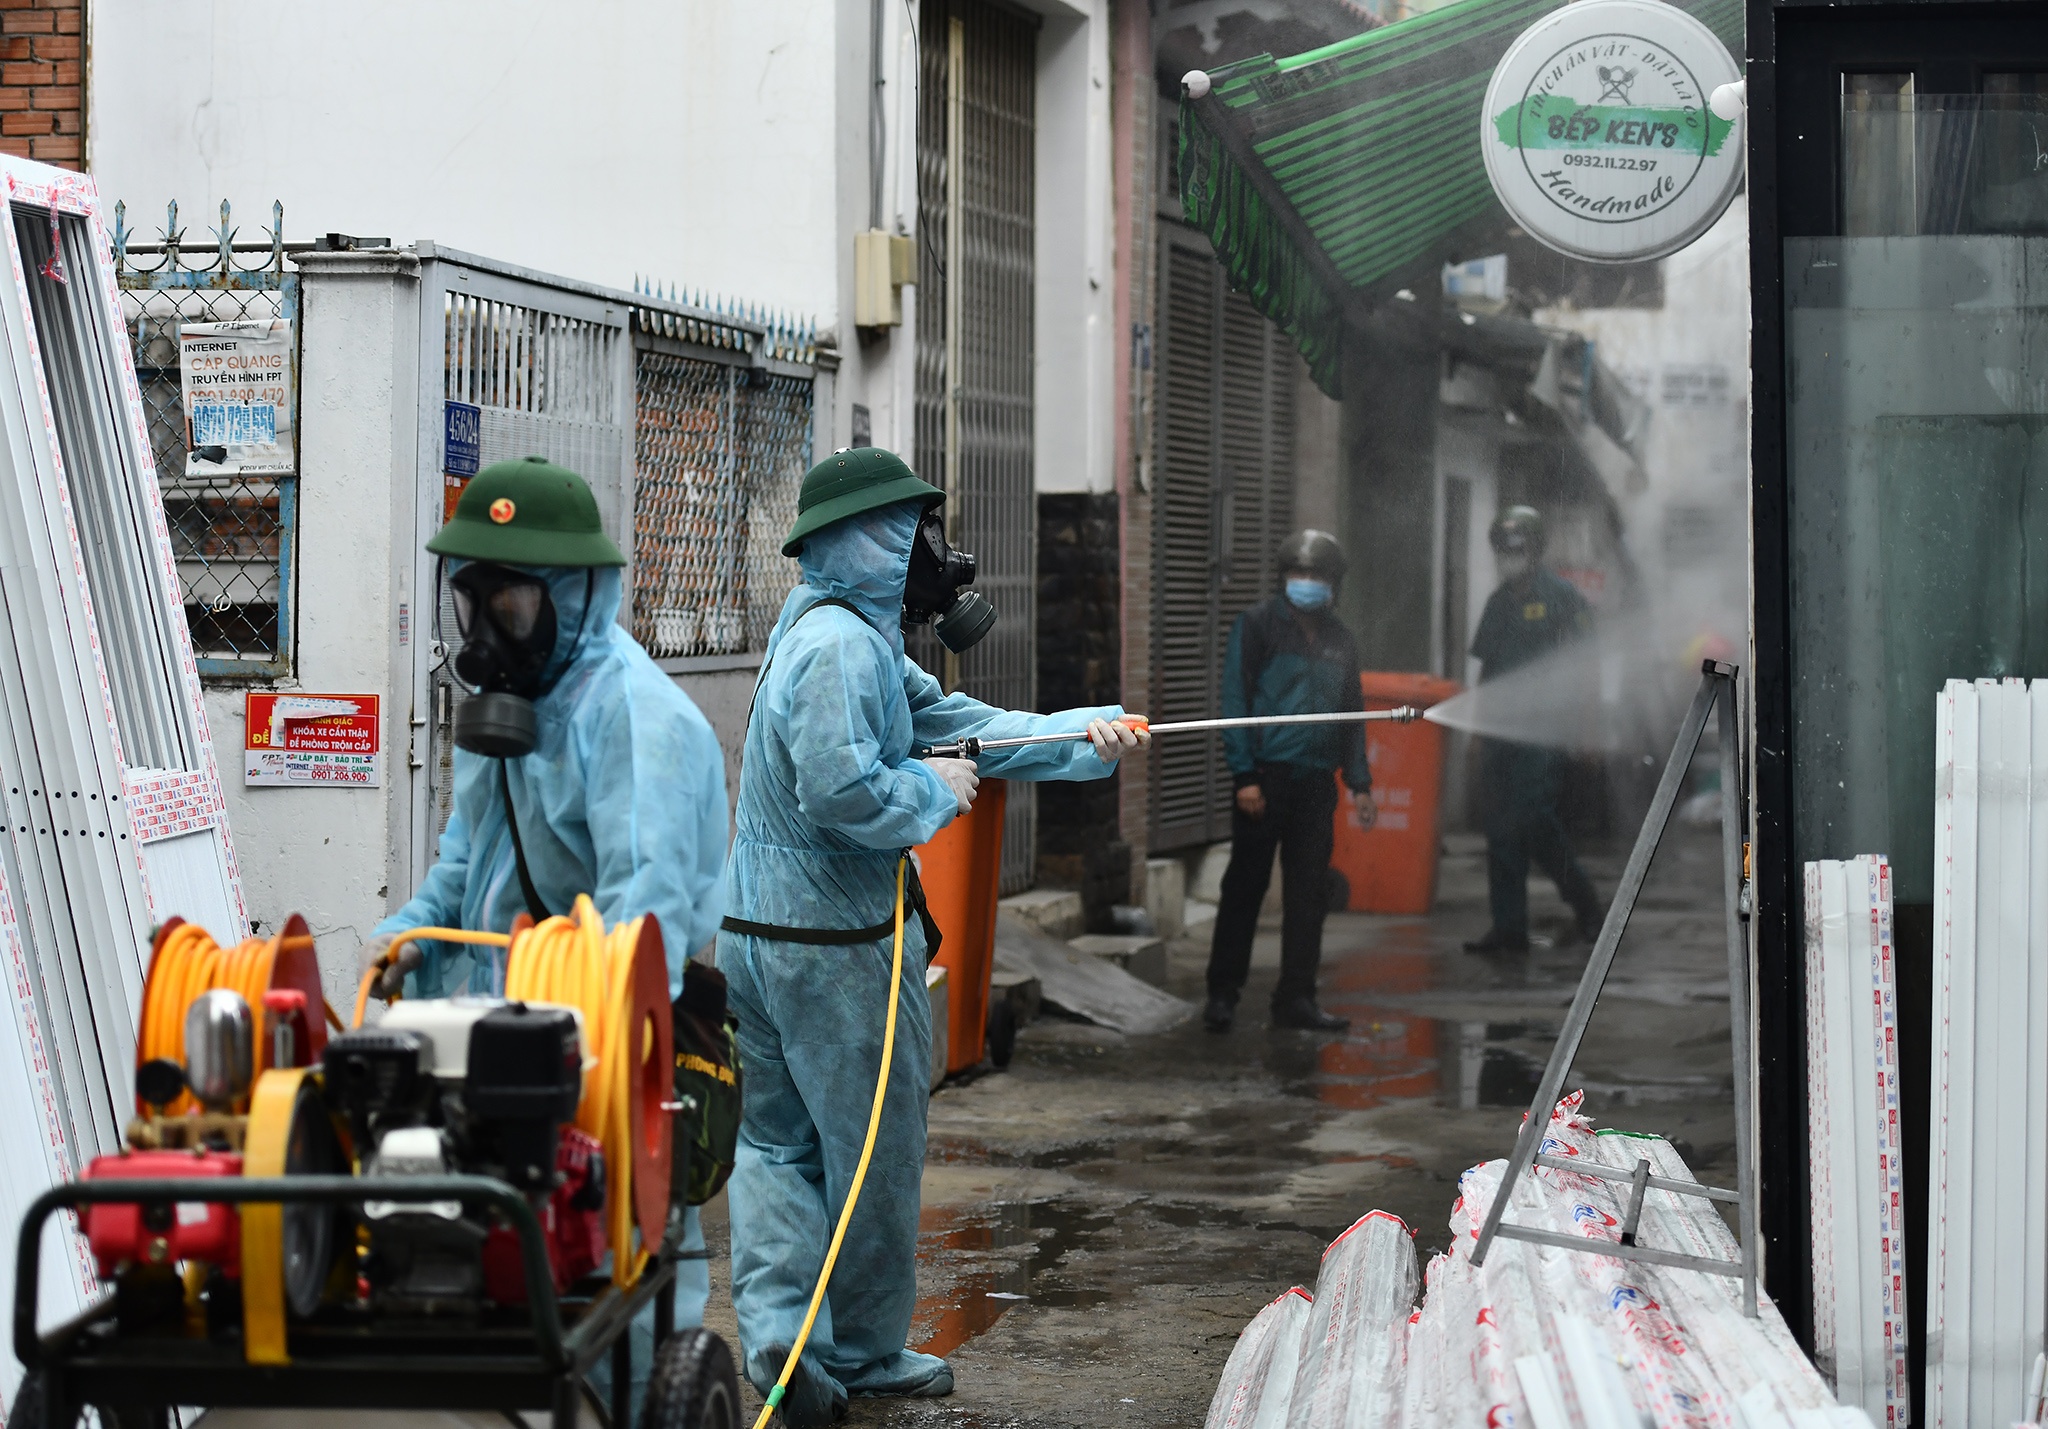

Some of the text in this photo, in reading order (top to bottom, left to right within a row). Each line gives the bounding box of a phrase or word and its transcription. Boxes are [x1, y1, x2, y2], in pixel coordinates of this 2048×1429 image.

[1547, 104, 1679, 148] BẾP KEN'S
[1562, 153, 1658, 172] 0932.11.22.97
[1541, 170, 1675, 214] Handmade
[184, 341, 238, 353] INTERNET
[191, 354, 282, 371] CÁP QUANG
[266, 372, 282, 381] FPT
[293, 725, 316, 736] KHÓA
[317, 728, 327, 737] XE
[301, 738, 330, 749] PHÒNG
[311, 770, 367, 781] 0901.206.906
